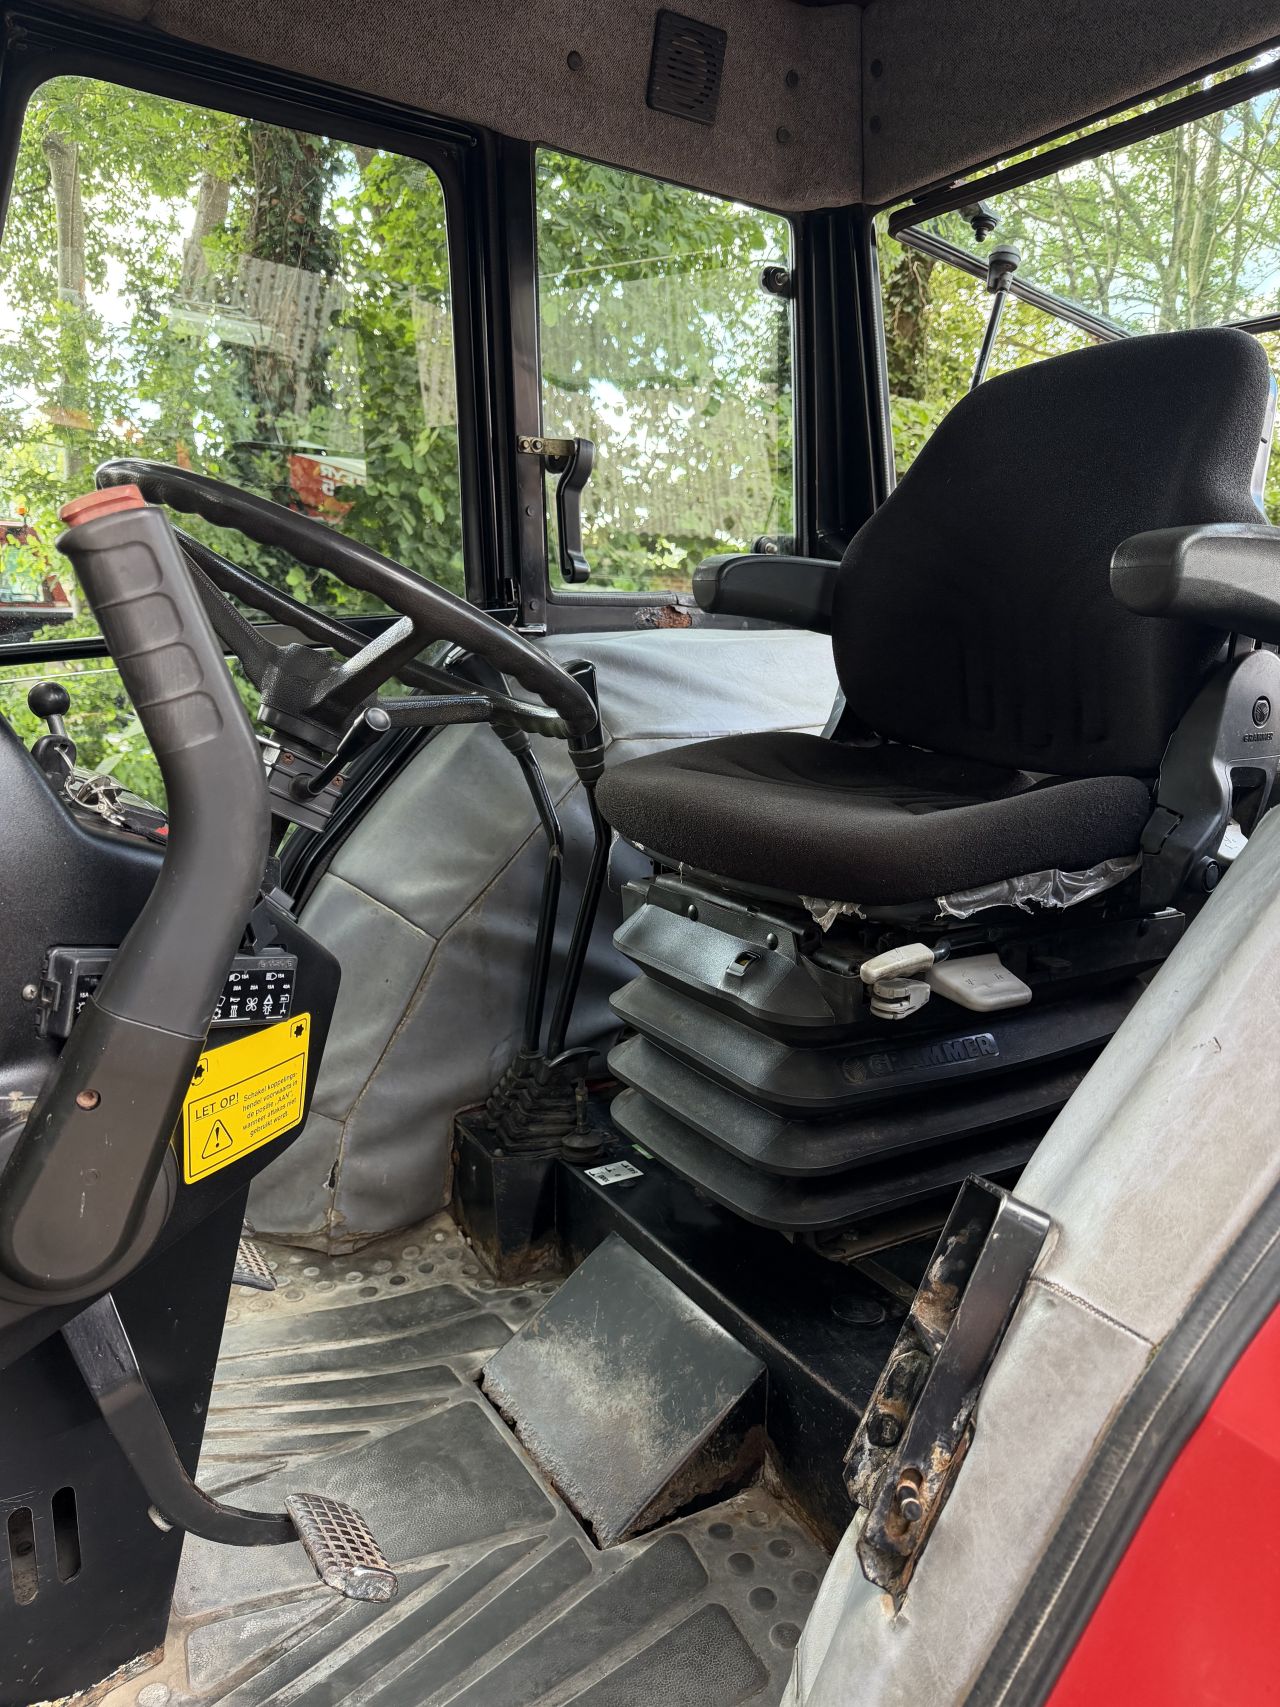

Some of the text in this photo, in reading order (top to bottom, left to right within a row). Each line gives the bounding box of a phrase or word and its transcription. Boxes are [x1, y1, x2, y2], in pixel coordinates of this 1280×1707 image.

[242, 1097, 262, 1112] hendel
[263, 1083, 292, 1102] voorwaarts
[243, 1072, 298, 1102] Schakel koppelings-
[195, 1092, 239, 1120] LET OP!
[242, 1097, 297, 1130] wanneer aftakas niet
[246, 1111, 255, 1119] de
[255, 1101, 274, 1116] positie
[249, 1119, 273, 1138] gebruikt
